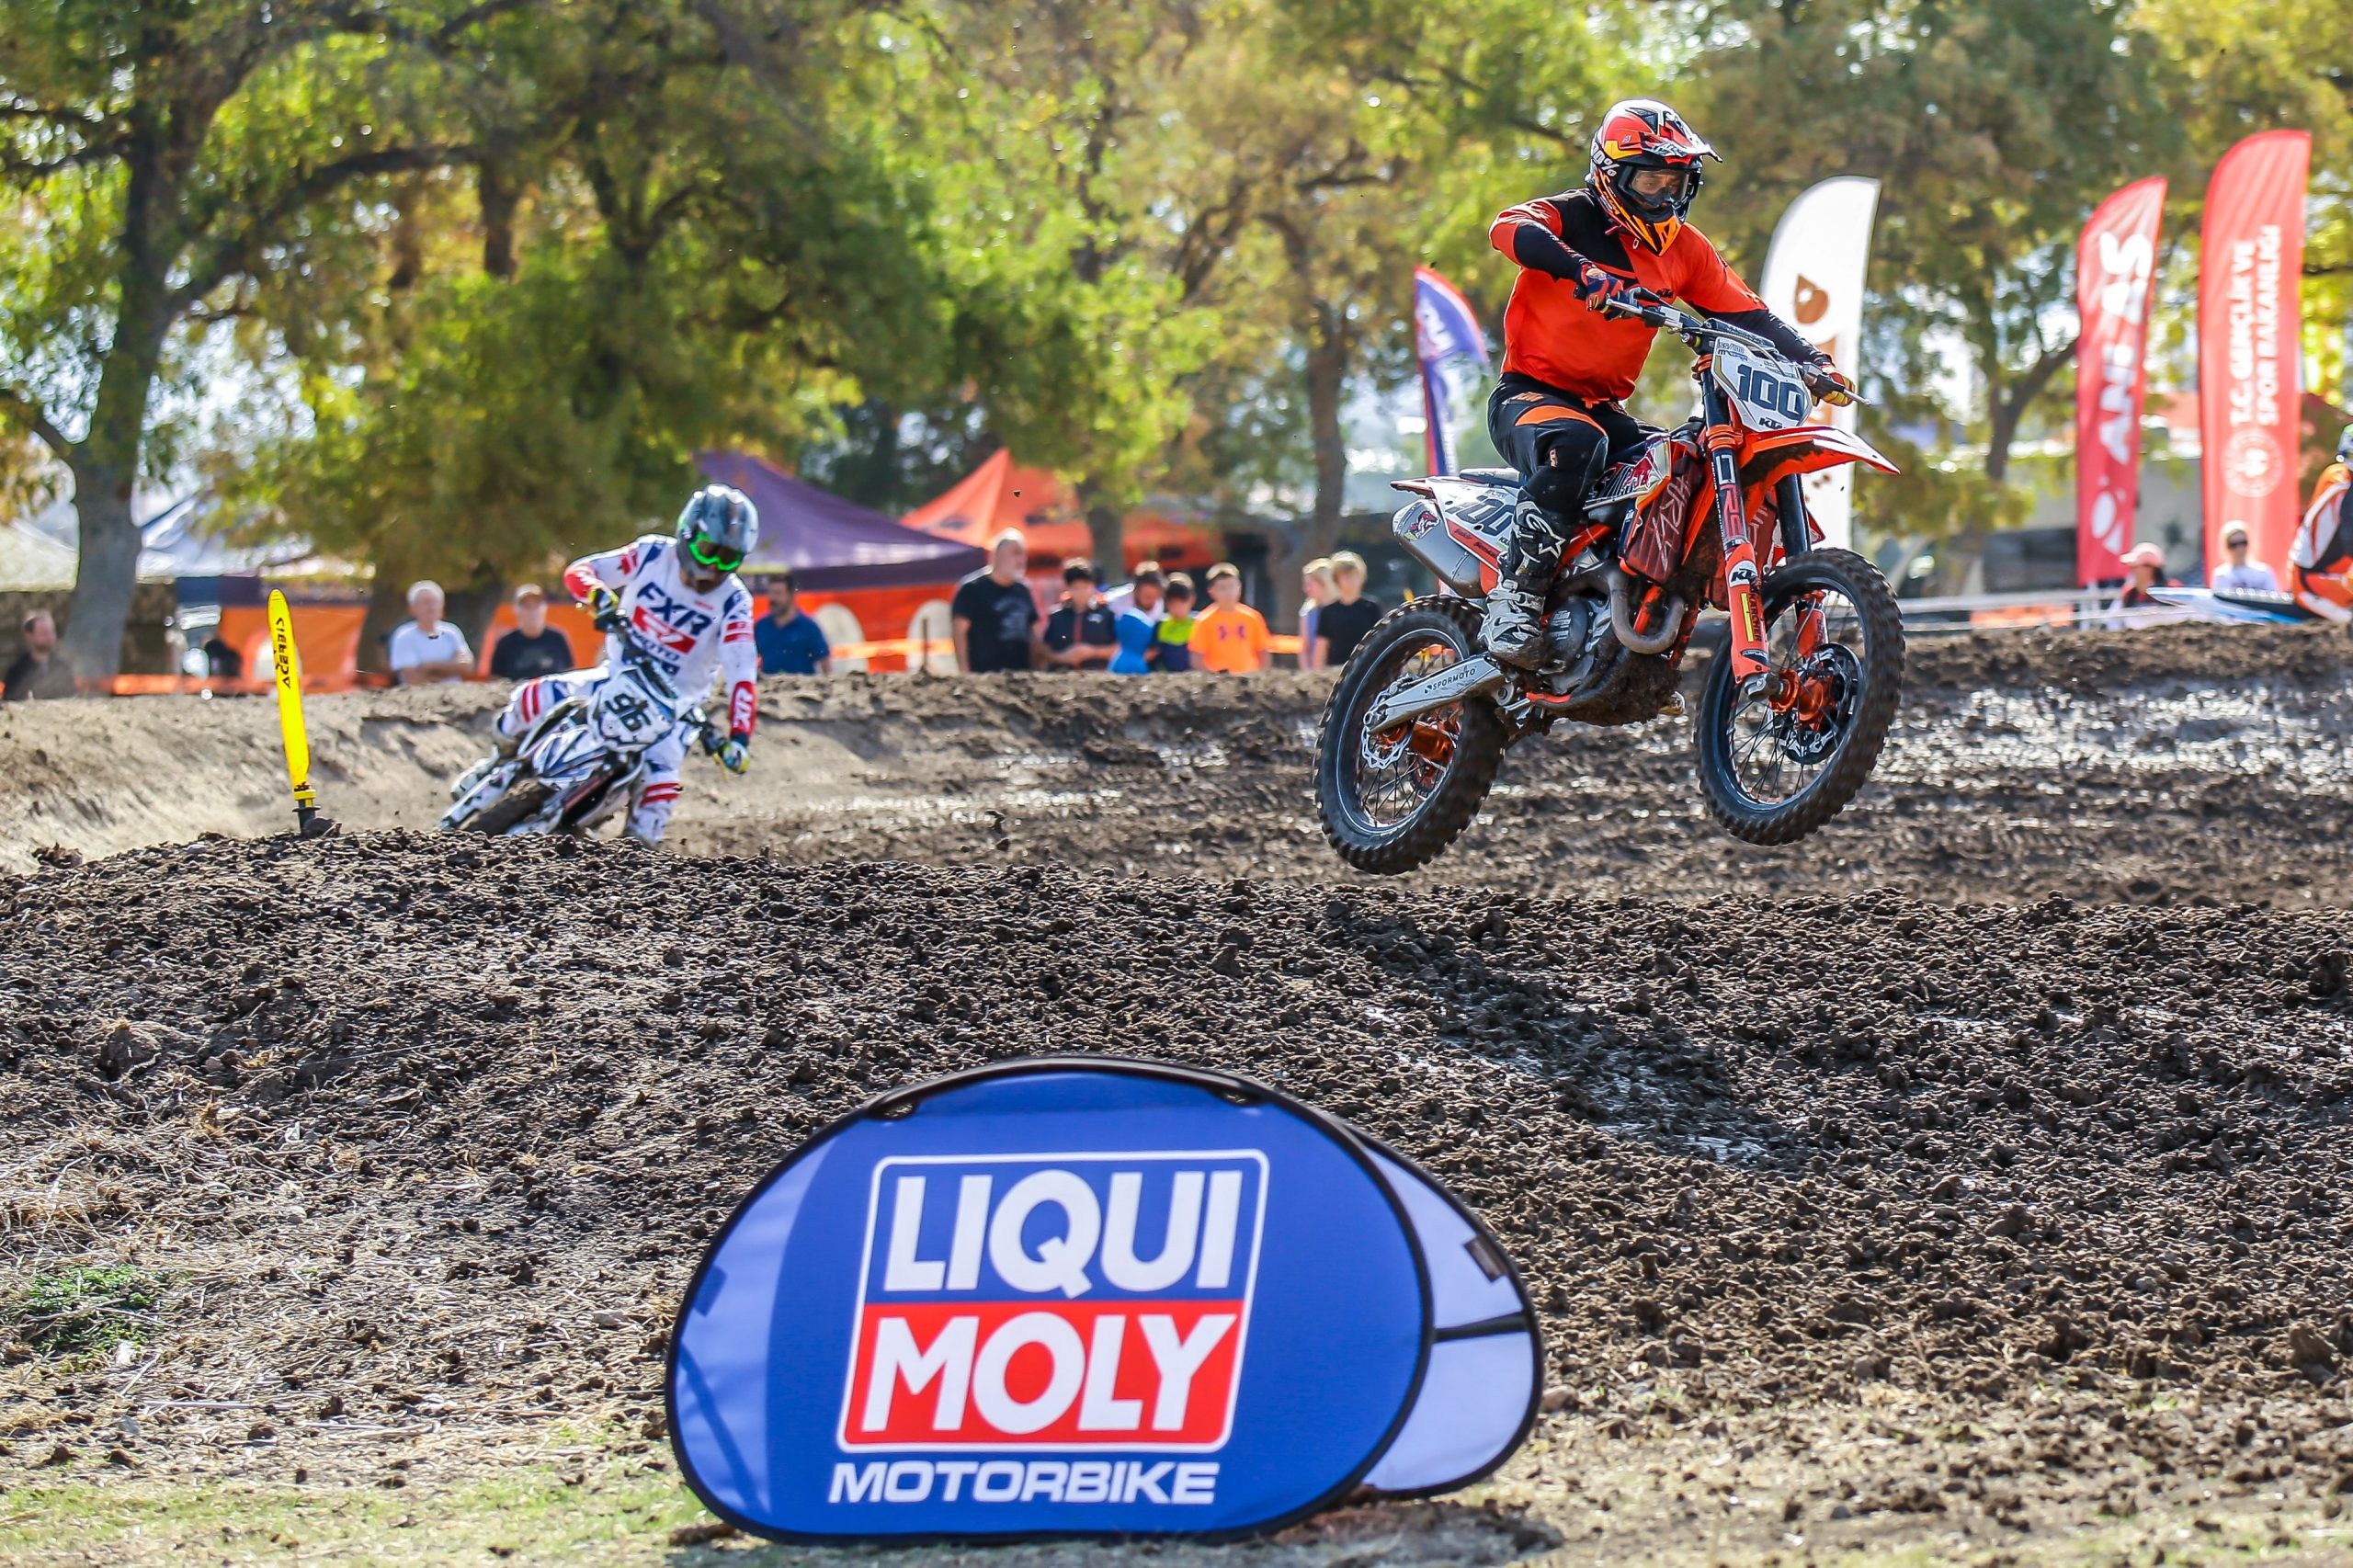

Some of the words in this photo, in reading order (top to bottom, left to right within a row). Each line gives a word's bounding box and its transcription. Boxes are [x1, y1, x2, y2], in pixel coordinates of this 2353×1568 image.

[1737, 363, 1805, 422] 100
[637, 581, 712, 636] FXR
[1432, 667, 1477, 691] SPORMOTO
[605, 692, 652, 733] 96
[882, 1169, 1244, 1299] LIQUI
[860, 1310, 1239, 1435] MOLY
[828, 1460, 1221, 1506] MOTORBIKE
